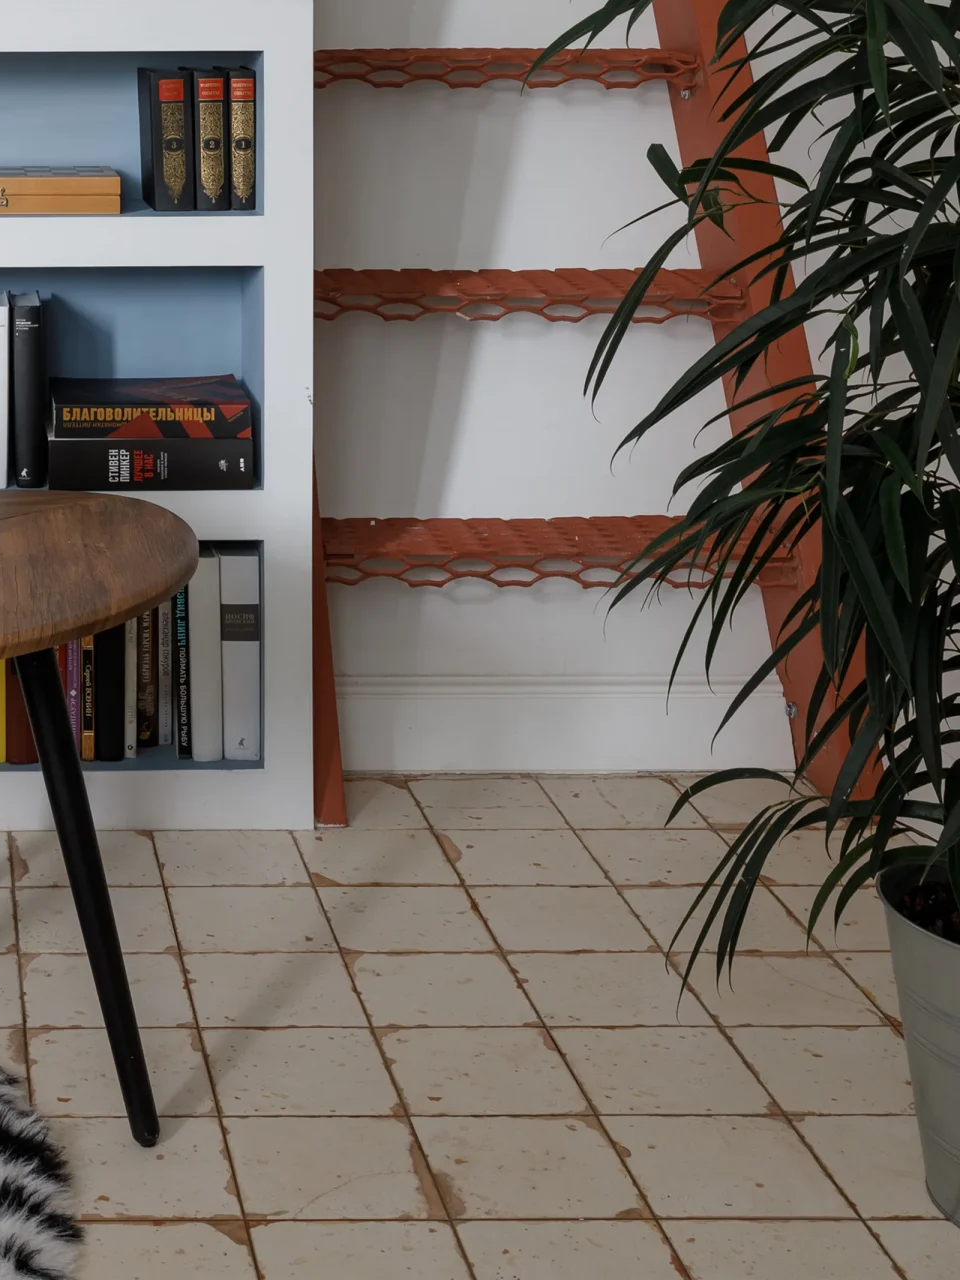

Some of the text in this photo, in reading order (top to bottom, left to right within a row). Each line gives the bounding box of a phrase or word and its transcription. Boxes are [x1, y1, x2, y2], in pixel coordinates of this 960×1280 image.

[171, 140, 177, 149] 3
[209, 140, 215, 149] 2
[240, 140, 246, 149] 1
[108, 449, 119, 483] СТИВЕН
[119, 449, 130, 482] ПИНКЕР
[133, 449, 144, 482] ЛУЧШЕЕ
[144, 453, 154, 470] НАС
[142, 610, 150, 627] МАРК
[161, 611, 170, 648] александр
[176, 619, 186, 646] ЛИНЧ
[84, 664, 93, 687] Сергей
[161, 649, 170, 677] сокуров
[179, 647, 187, 683] ПОЙМАТЬ
[180, 684, 188, 724] БОЛЬШУЮ
[180, 725, 188, 746] РЫБУ
